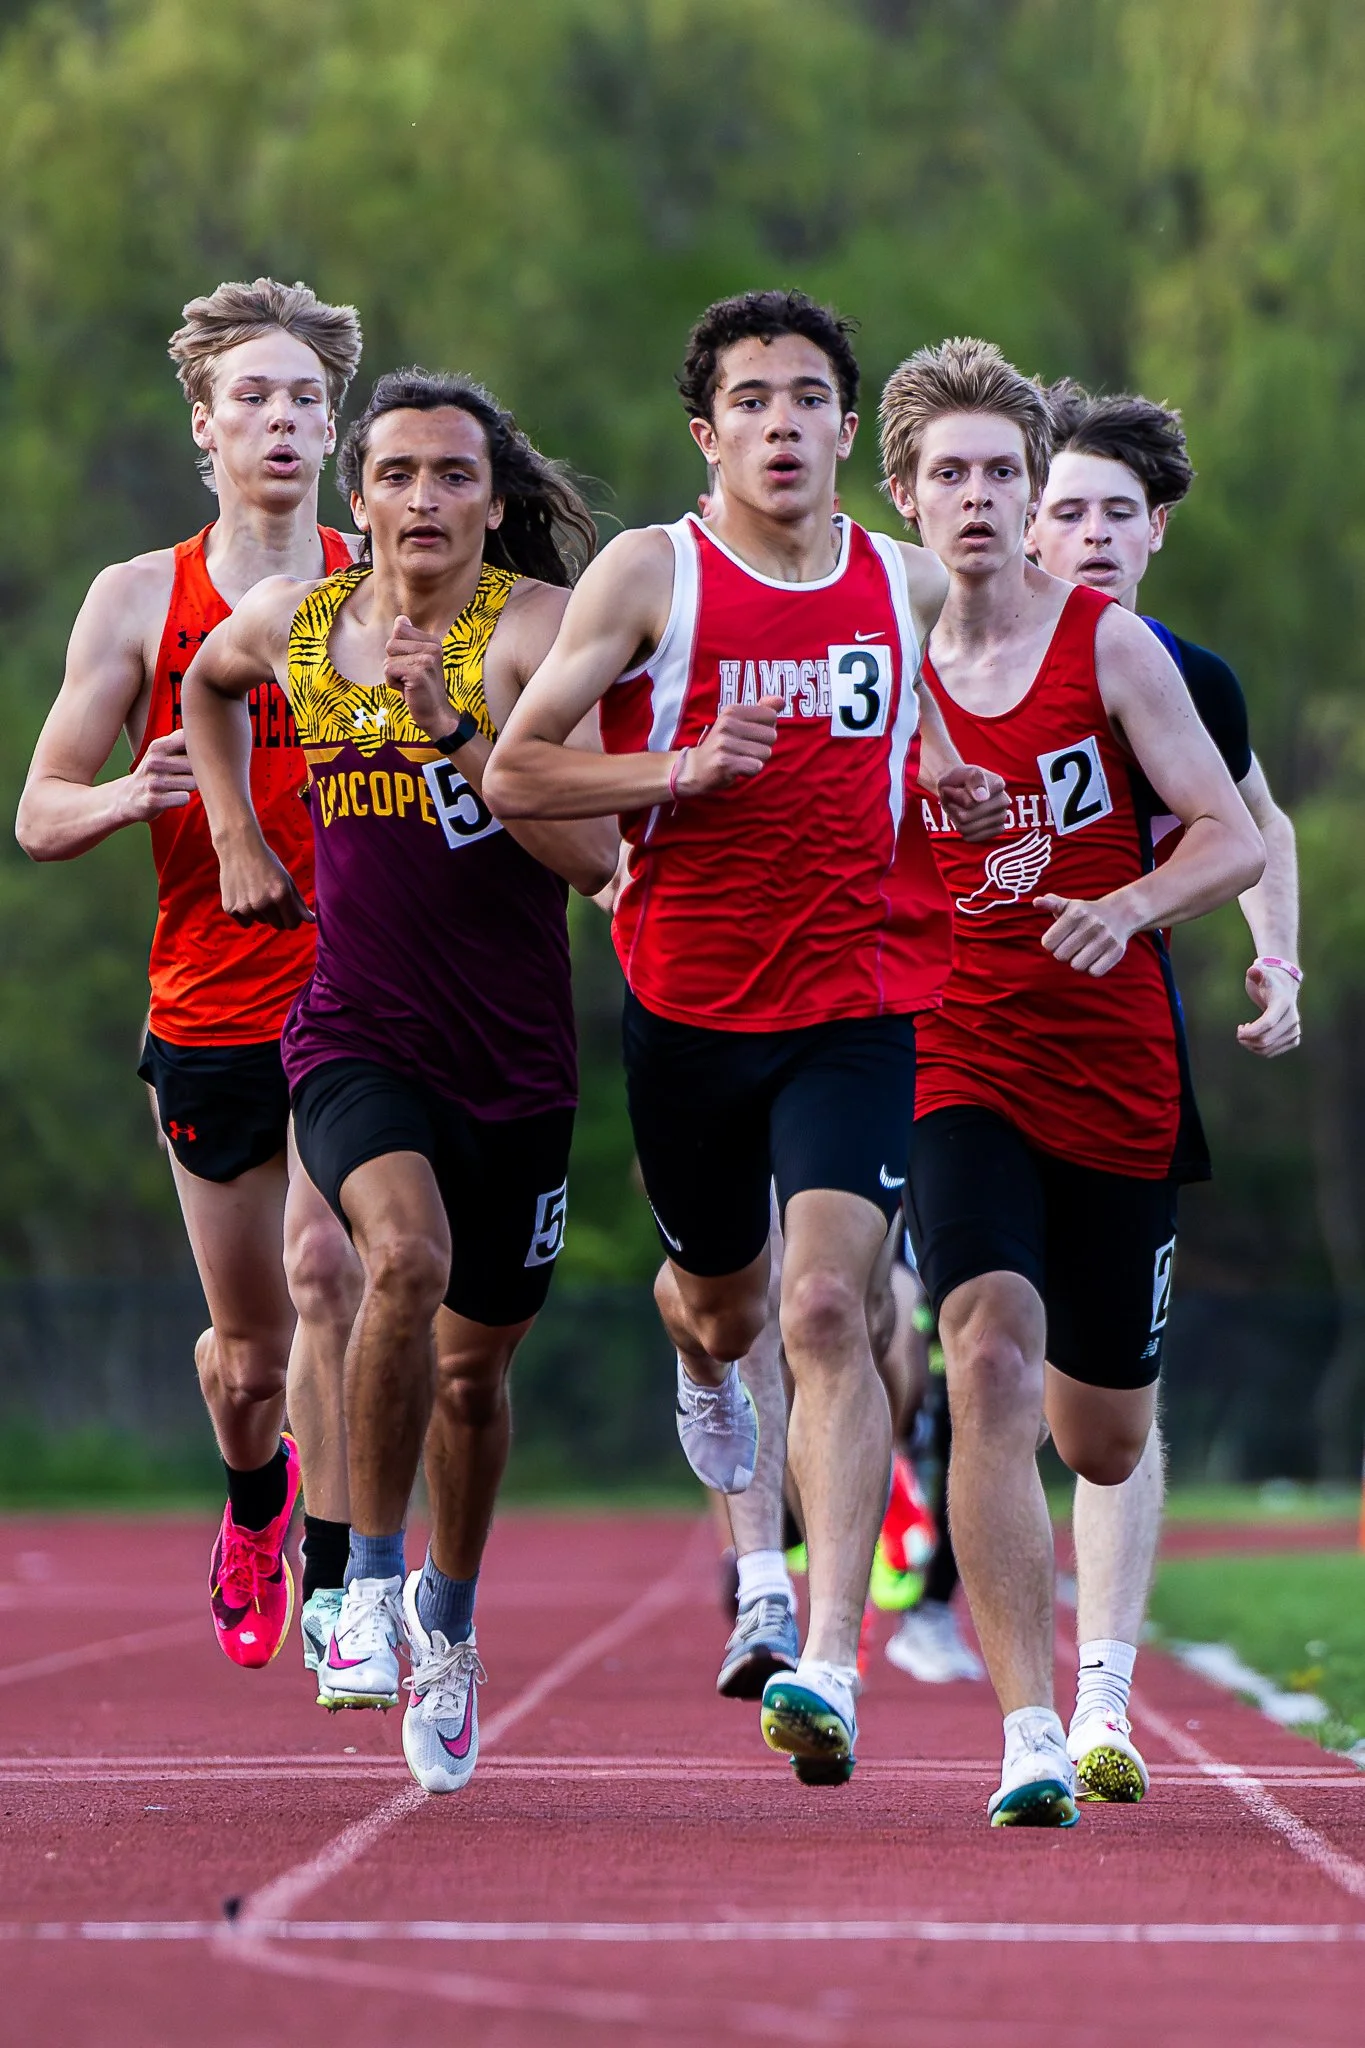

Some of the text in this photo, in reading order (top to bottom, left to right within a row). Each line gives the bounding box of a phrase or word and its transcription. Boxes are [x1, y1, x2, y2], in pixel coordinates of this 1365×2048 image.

[838, 651, 880, 730] 3
[434, 763, 493, 836] 5
[1050, 750, 1103, 829] 2
[535, 1185, 566, 1258] 5
[1155, 1246, 1173, 1325] 2
